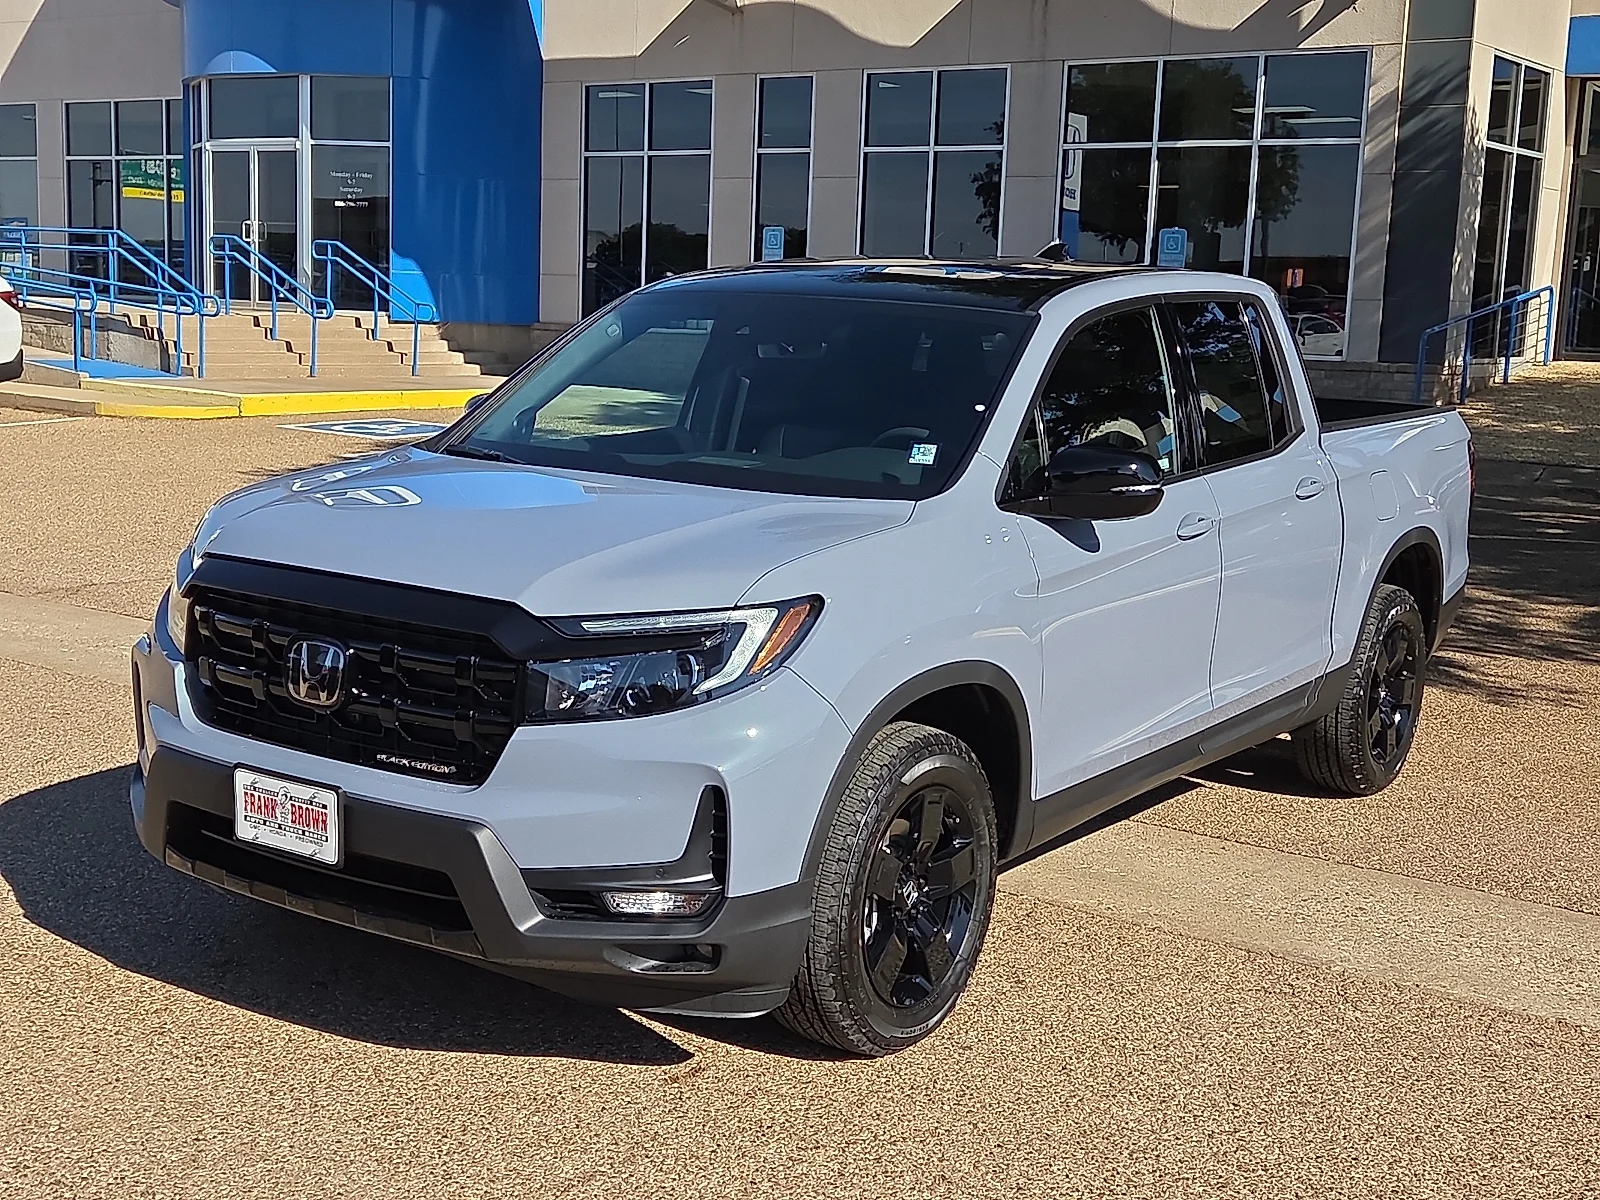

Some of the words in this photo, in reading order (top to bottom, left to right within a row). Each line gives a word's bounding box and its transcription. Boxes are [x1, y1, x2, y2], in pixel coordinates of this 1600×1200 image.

[376, 754, 410, 767] BLACK
[243, 791, 279, 821] FRANK
[290, 803, 329, 834] BROWN
[246, 815, 264, 825] AUTO
[265, 820, 279, 829] AND
[281, 824, 303, 835] TRUCK
